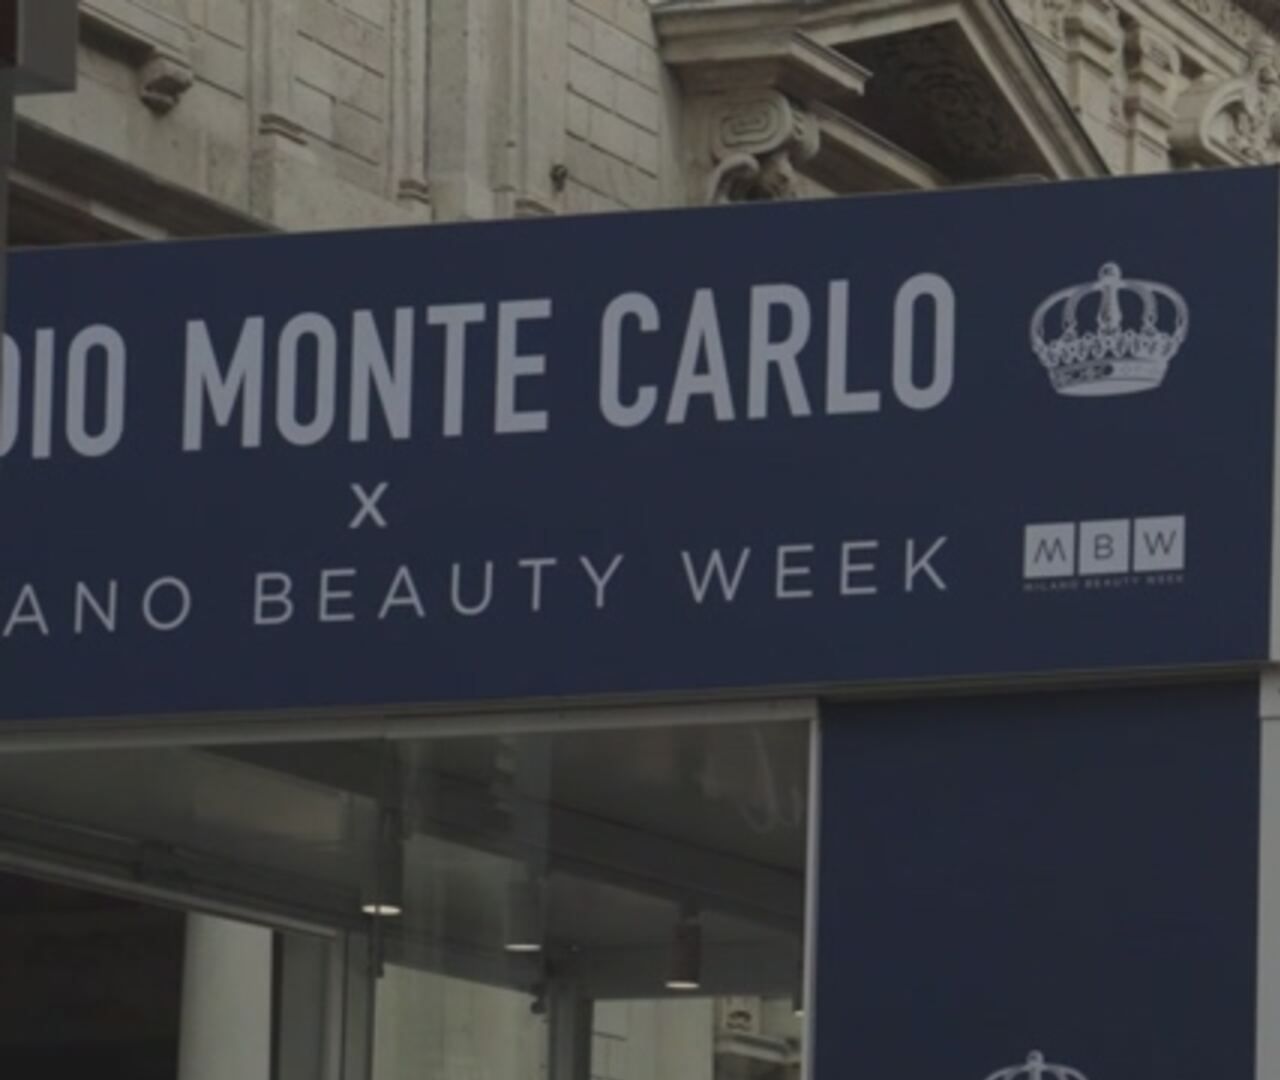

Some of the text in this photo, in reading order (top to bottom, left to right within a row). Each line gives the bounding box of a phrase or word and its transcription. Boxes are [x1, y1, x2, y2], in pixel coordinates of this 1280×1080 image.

[182, 297, 553, 452] MONTE
[599, 271, 956, 429] CARLO
[2, 535, 948, 638] ANO BEAUTY WEEK
